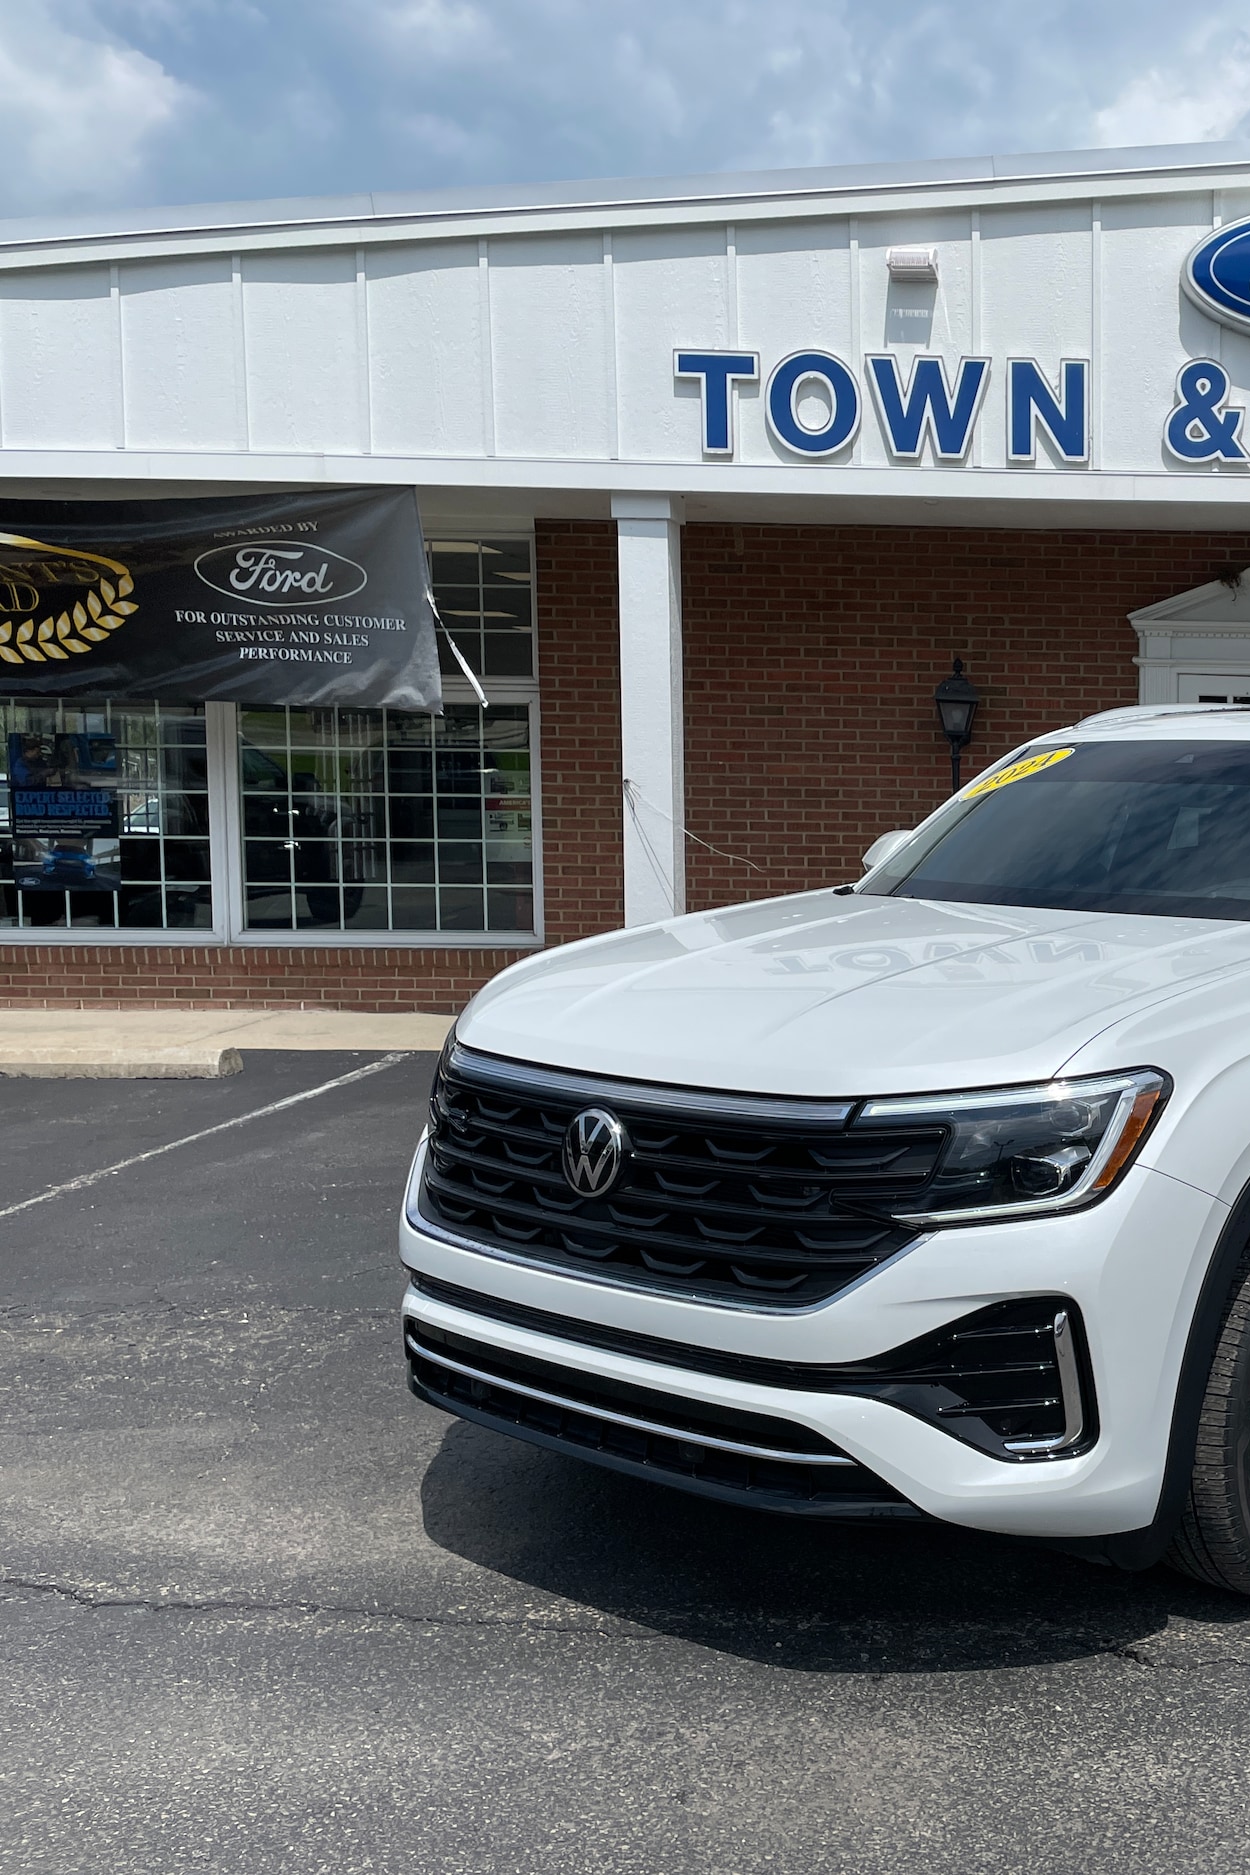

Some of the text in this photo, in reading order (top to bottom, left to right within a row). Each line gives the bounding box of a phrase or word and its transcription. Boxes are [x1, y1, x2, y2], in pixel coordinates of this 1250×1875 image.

[674, 349, 1092, 463] TOWN
[213, 521, 319, 539] AWARDED BY
[230, 548, 333, 593] Ford
[175, 610, 407, 631] FOR OUTSTANDING CUSTOMER
[216, 630, 369, 647] SERVICE AND SALES
[240, 647, 352, 664] PERFORMANCE
[976, 752, 1056, 795] 2024
